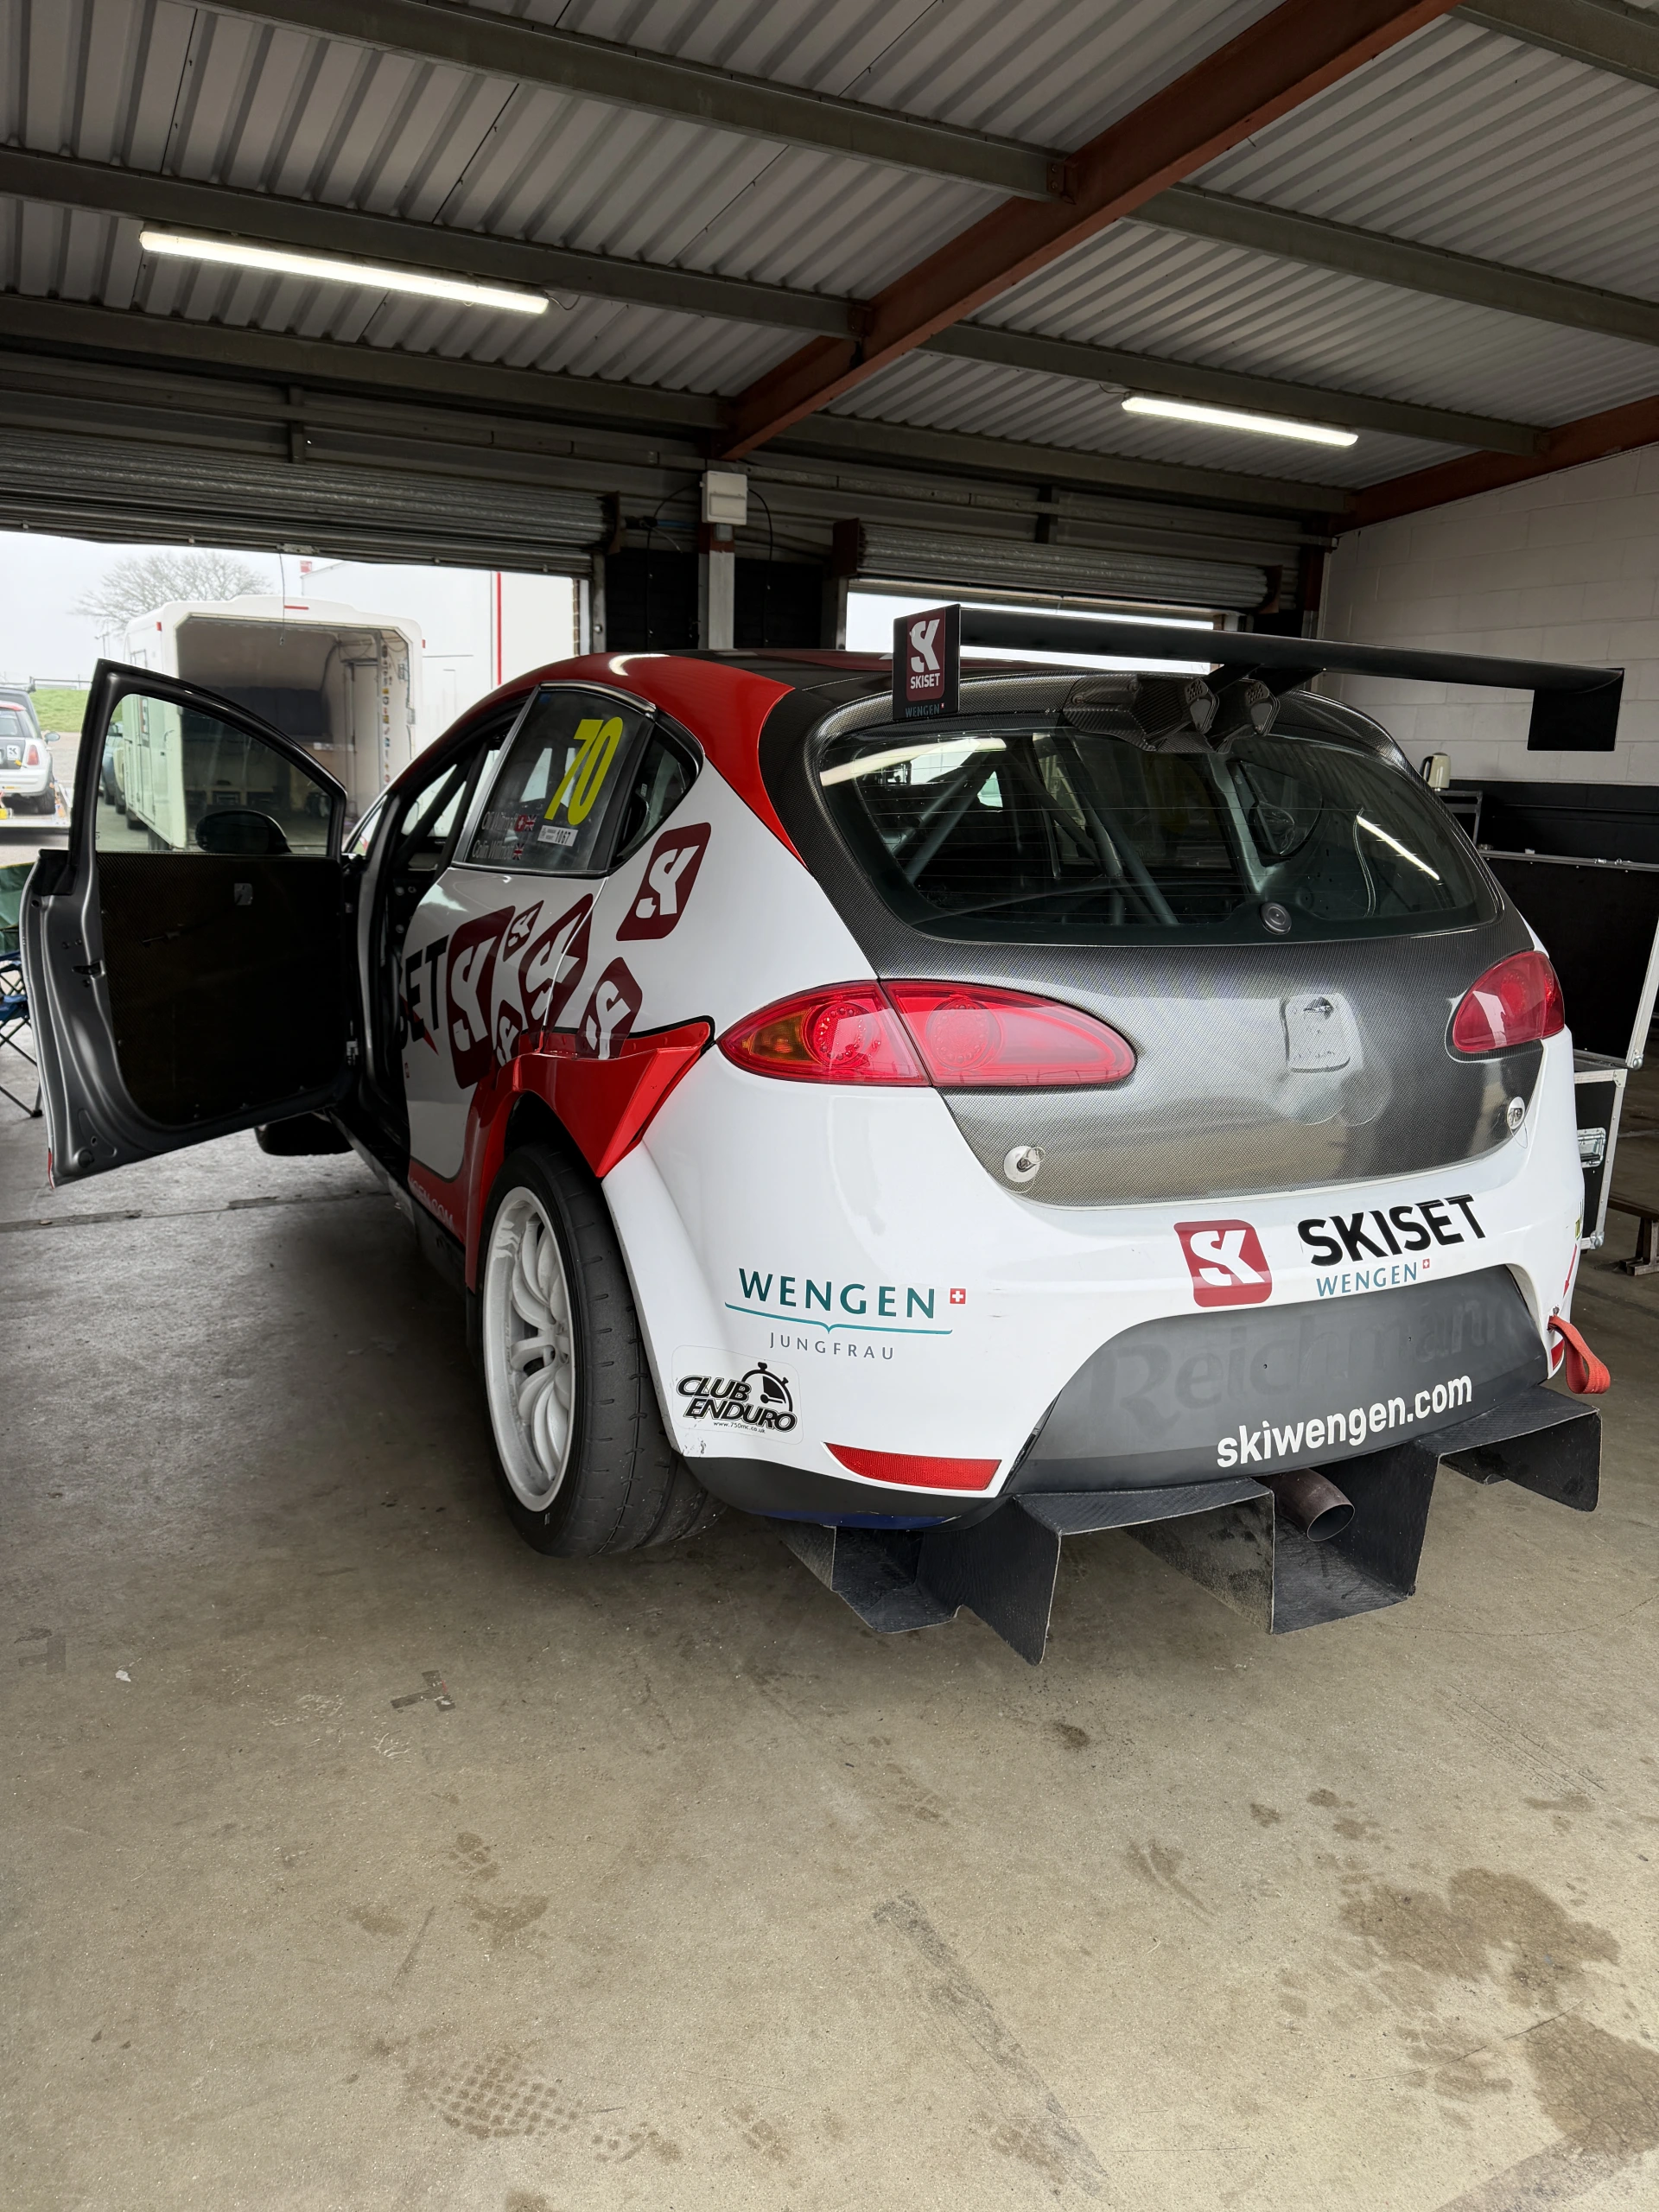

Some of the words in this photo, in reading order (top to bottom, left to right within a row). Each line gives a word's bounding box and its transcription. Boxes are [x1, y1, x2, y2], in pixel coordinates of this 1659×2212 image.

[910, 673, 941, 690] SKISET
[905, 703, 940, 718] WENGEN
[544, 716, 624, 825] 70
[555, 830, 571, 844] 1067
[1297, 1194, 1486, 1268] SKISET
[738, 1268, 936, 1319] WENGEN
[1315, 1262, 1418, 1298] WENGEN
[770, 1332, 894, 1360] JUNGFRAU
[677, 1375, 752, 1402] CLUB
[683, 1396, 798, 1433] ENDURO
[713, 1421, 766, 1433] www.750mc.co.uk
[1217, 1374, 1472, 1468] skiwengen.com
